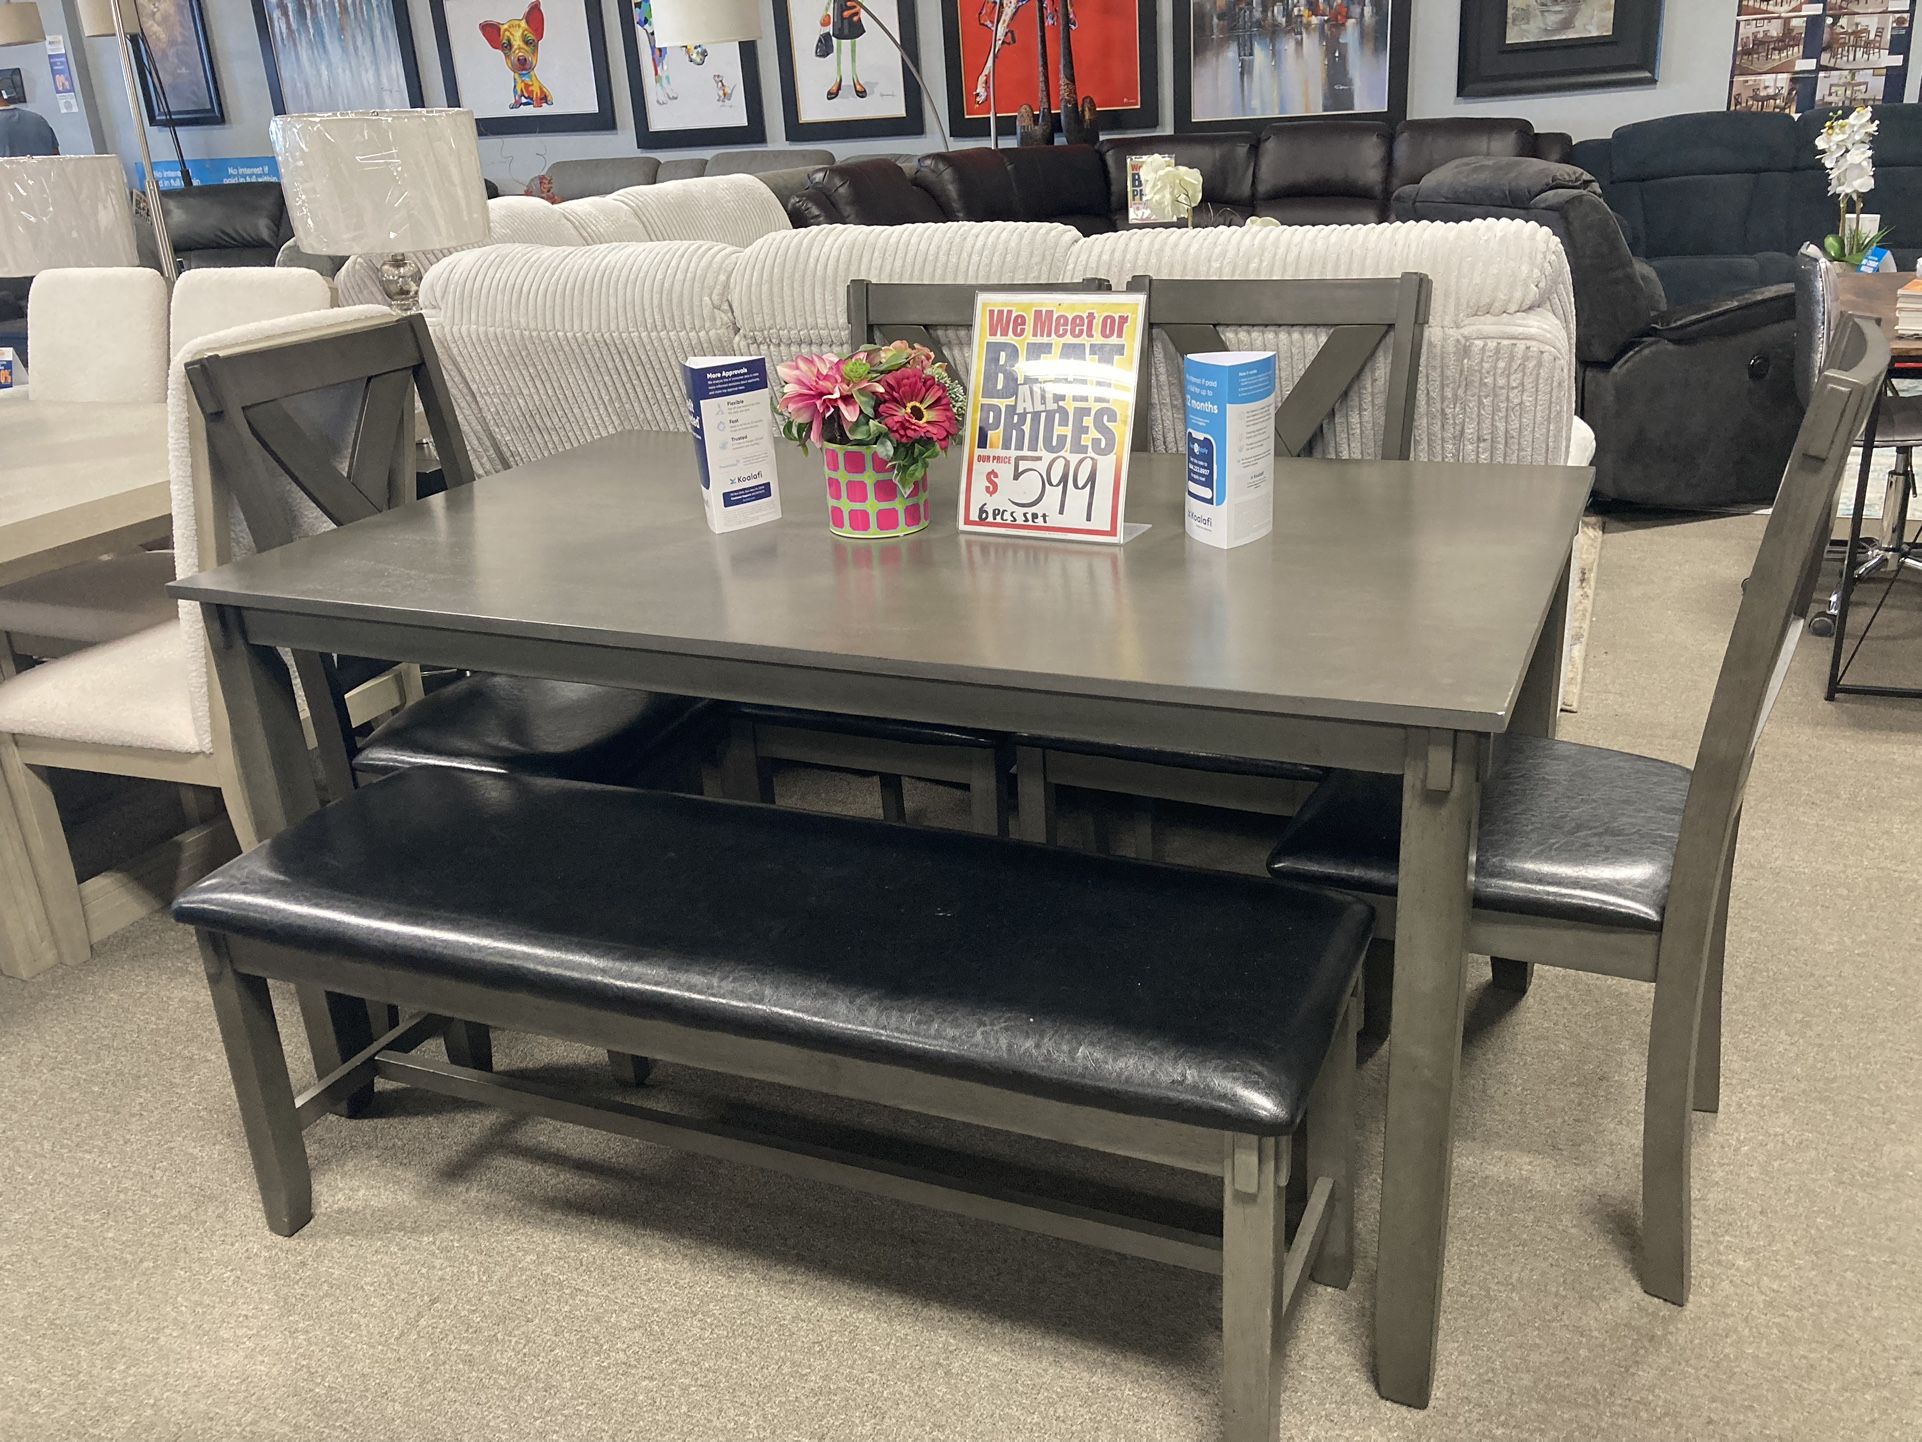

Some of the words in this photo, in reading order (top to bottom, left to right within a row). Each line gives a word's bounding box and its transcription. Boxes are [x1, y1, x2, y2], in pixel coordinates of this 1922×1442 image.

[228, 166, 238, 175] No
[238, 166, 263, 175] interest
[263, 165, 269, 174] if
[988, 308, 1027, 338] We
[1031, 309, 1096, 339] Meet
[1100, 313, 1129, 339] or
[722, 367, 748, 377] Approvals
[981, 341, 1126, 403] BEAT
[1015, 382, 1059, 414] ALL
[1191, 400, 1218, 414] months
[977, 403, 1118, 456] PRICES
[977, 454, 991, 463] OUR
[992, 455, 1012, 465] PRICE
[737, 470, 763, 483] Koalafi
[984, 469, 999, 497] $
[1008, 455, 1098, 522] 599
[977, 502, 989, 522] 6
